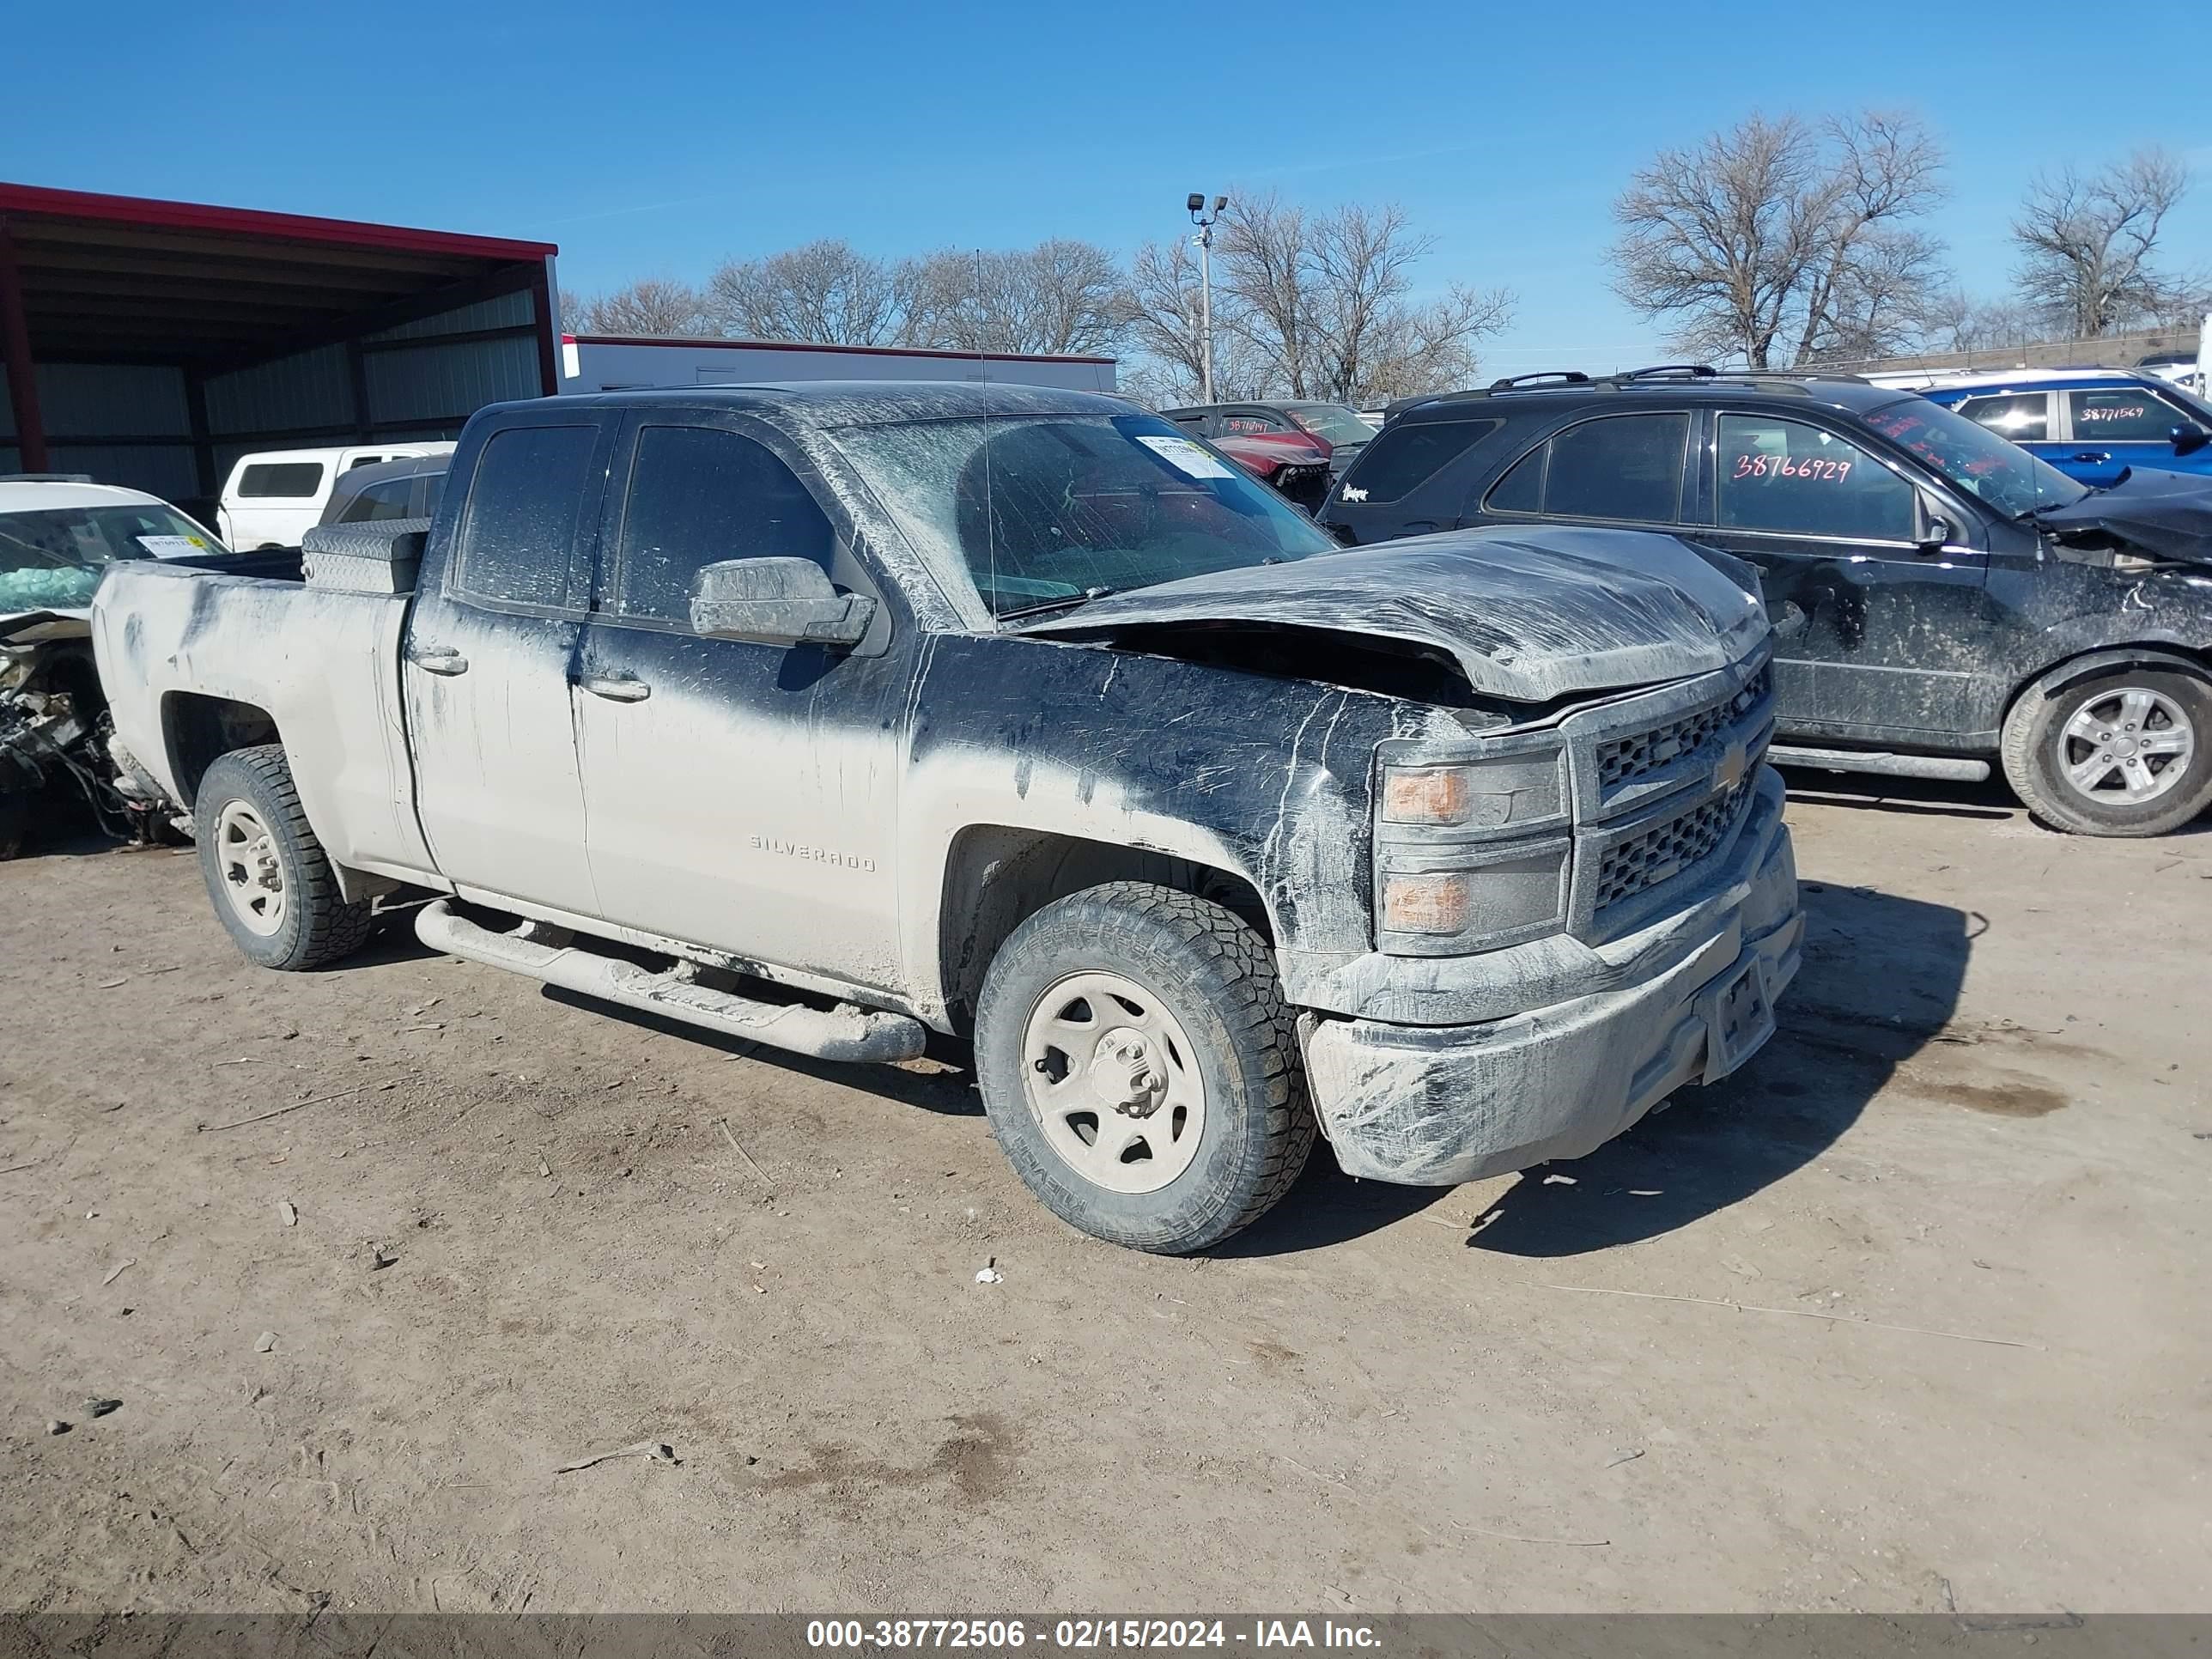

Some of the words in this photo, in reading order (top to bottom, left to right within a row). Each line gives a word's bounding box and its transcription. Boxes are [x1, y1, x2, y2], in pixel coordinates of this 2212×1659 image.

[2081, 407, 2144, 422] 38771569
[1733, 454, 1852, 483] 38766929
[750, 835, 876, 872] SILVERADO
